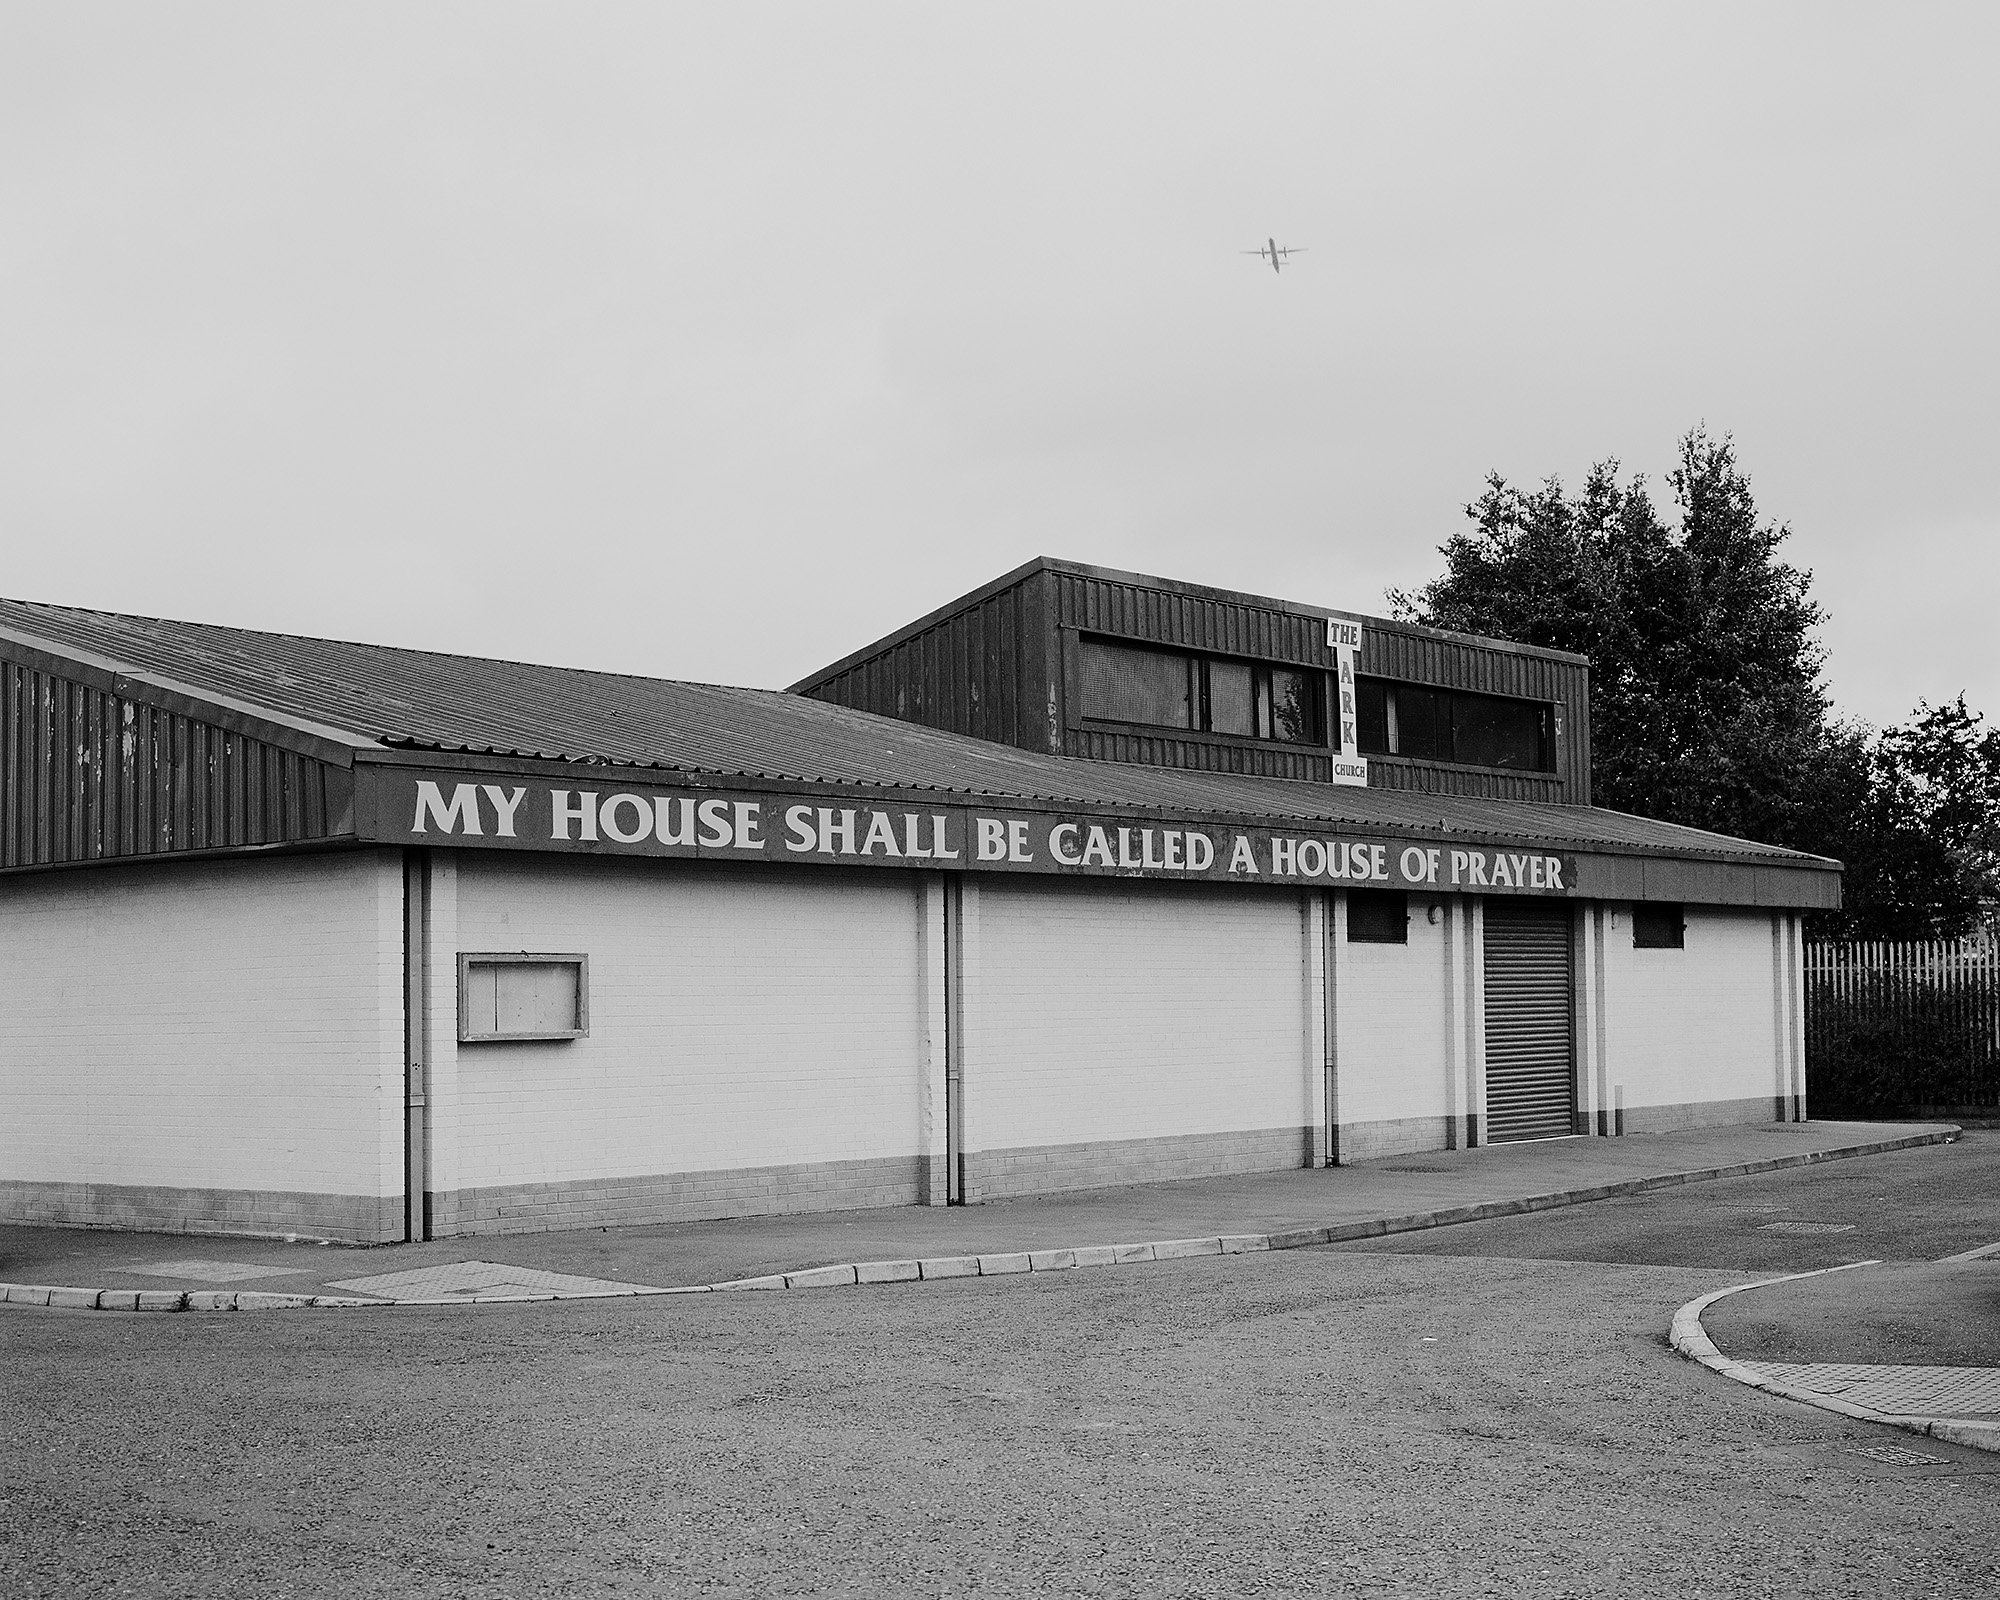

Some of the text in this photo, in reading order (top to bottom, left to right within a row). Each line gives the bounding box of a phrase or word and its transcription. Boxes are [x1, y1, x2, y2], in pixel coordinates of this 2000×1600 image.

[1331, 623, 1358, 645] THE
[1340, 661, 1355, 744] ARK
[1334, 763, 1365, 778] CHURCH
[410, 780, 1565, 891] MY HOUSE SHALL BE CALLED A HOUSE OF PRAYER
